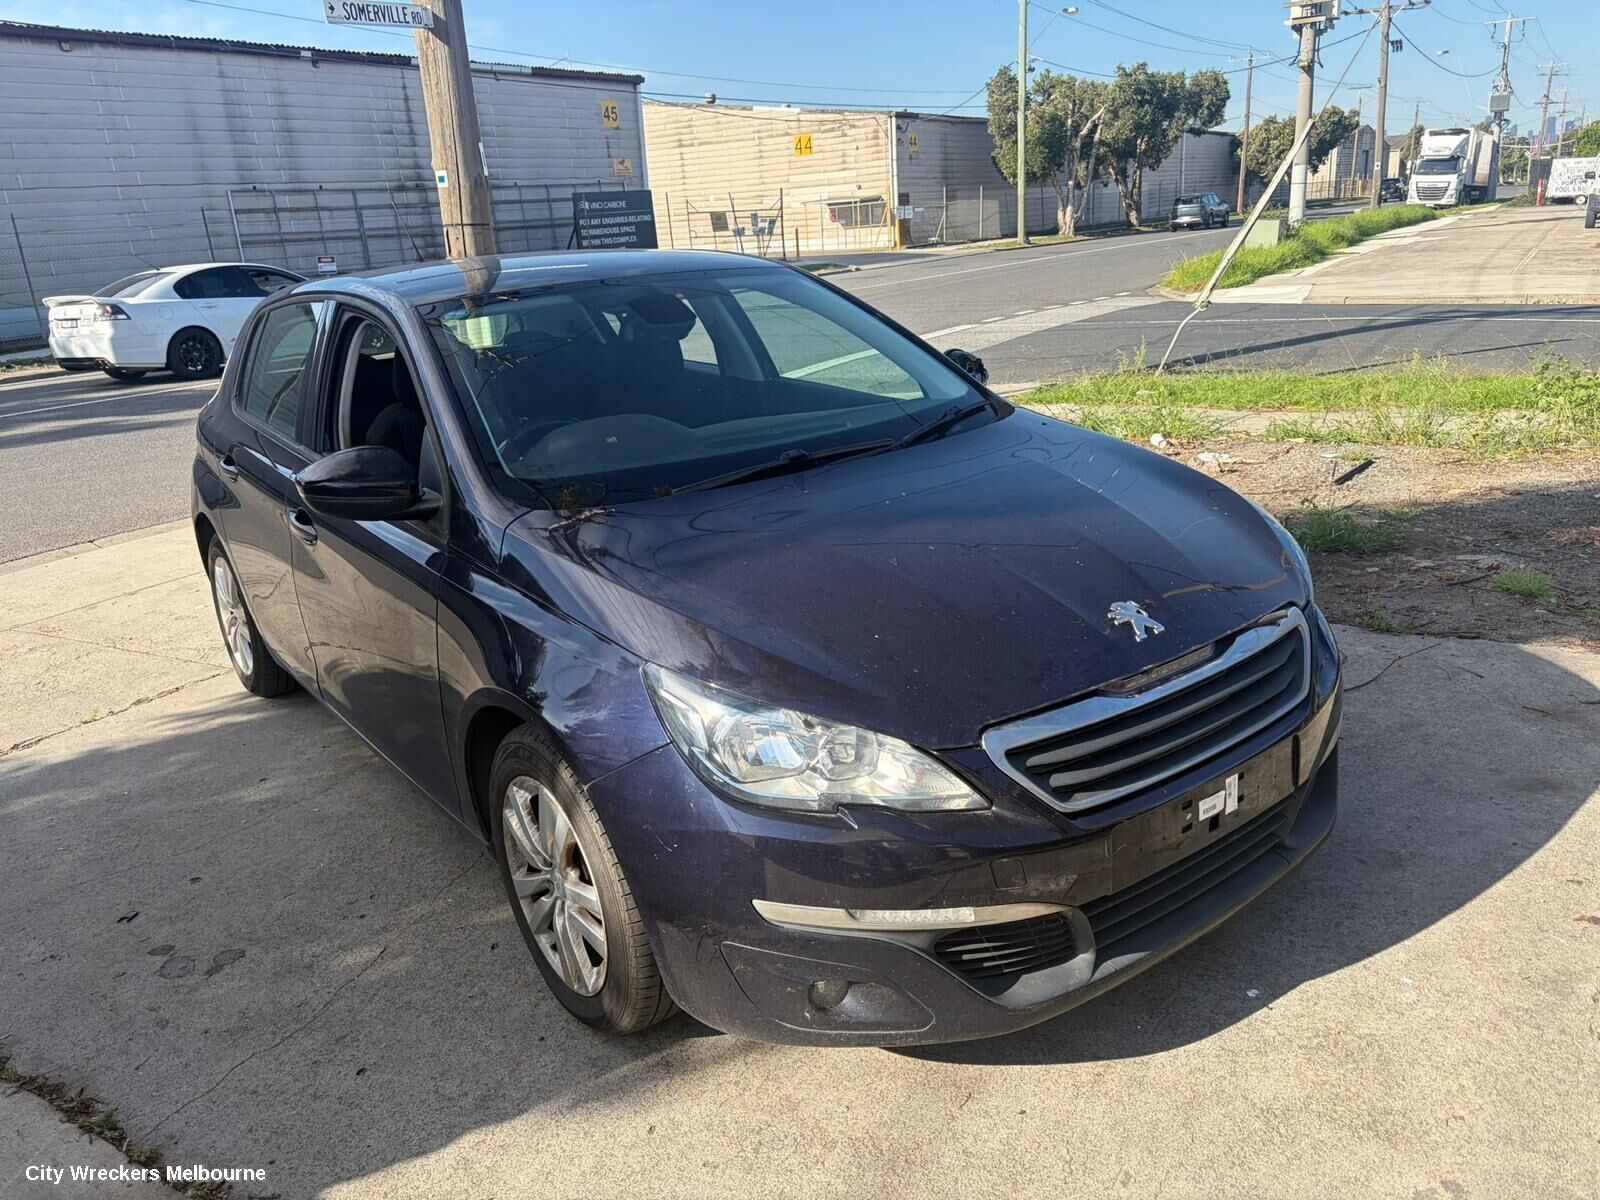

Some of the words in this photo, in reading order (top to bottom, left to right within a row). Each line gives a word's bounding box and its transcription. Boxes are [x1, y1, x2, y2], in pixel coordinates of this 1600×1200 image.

[342, 2, 410, 24] SOMERVILLE
[411, 10, 422, 25] RD
[603, 106, 618, 121] 45
[795, 135, 812, 155] 44
[603, 200, 627, 209] CARBONE
[590, 218, 601, 226] ANY
[628, 214, 652, 223] RELATING
[581, 229, 589, 237] TO
[589, 227, 620, 236] WAREHOUSE
[620, 225, 636, 233] SPACE
[582, 239, 601, 247] WITHIN
[601, 237, 612, 245] THIS
[613, 235, 637, 244] COMPLEX
